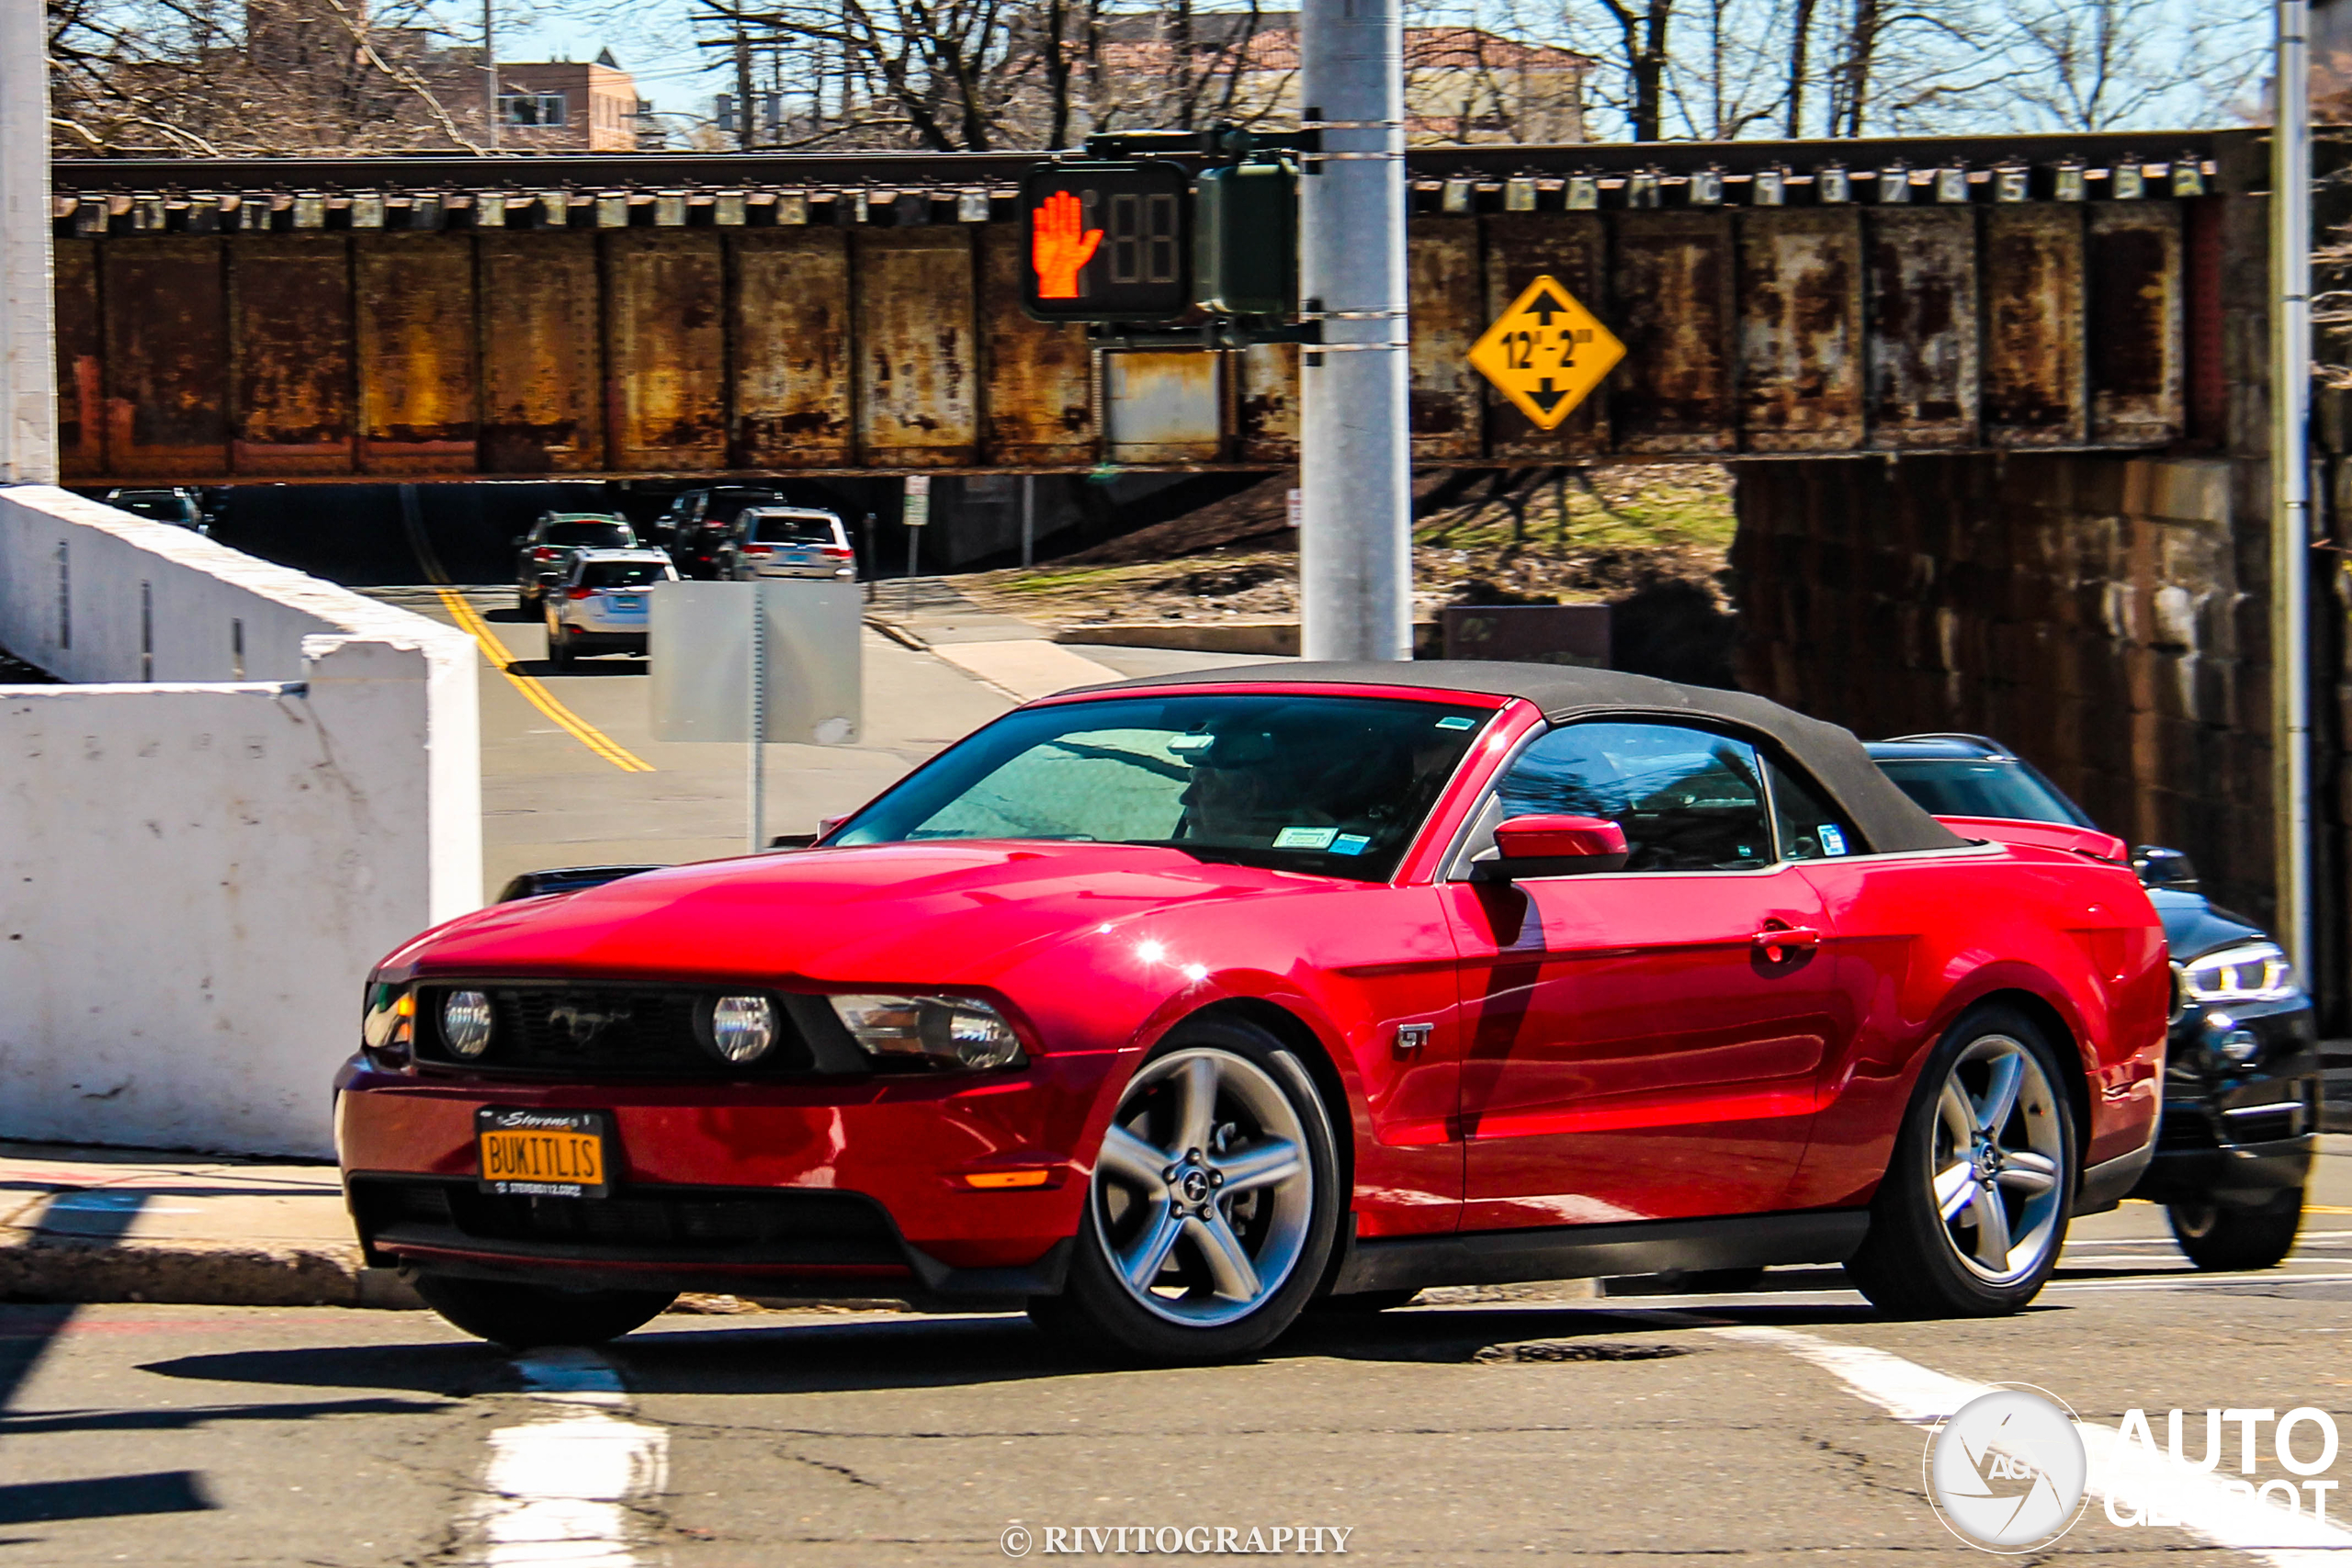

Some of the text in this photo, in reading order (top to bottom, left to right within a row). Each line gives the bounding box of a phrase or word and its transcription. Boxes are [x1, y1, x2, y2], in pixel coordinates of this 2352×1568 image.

[1881, 175, 1909, 203] 7
[2002, 174, 2027, 202] 5
[1398, 1022, 1434, 1047] GT
[489, 1135, 594, 1178] BUKITLIS
